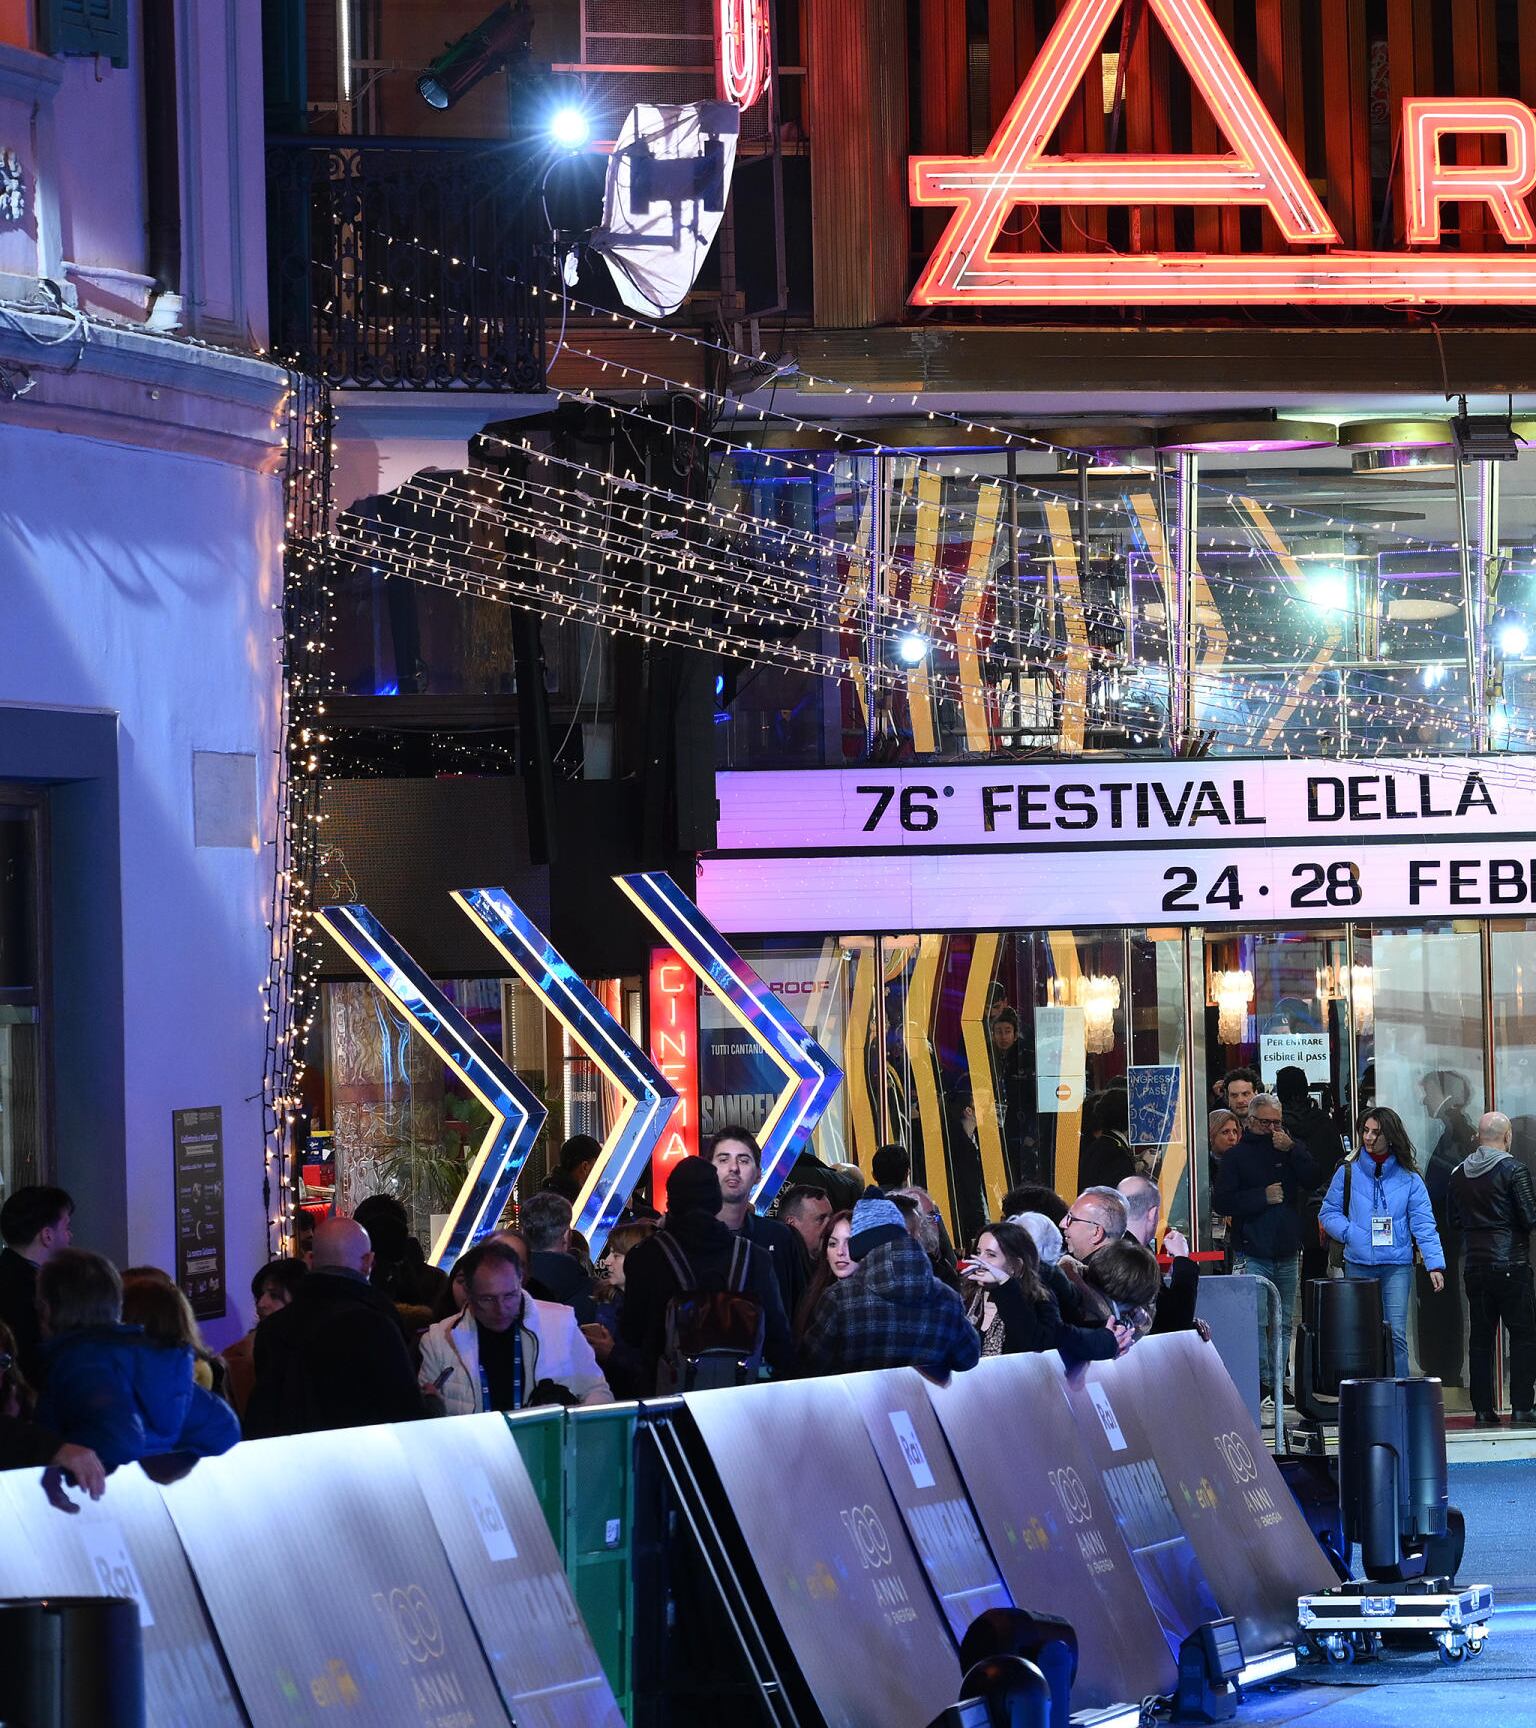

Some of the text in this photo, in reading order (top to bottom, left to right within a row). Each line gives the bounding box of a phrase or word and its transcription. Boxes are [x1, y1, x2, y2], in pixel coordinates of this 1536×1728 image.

[982, 779, 1267, 832] FESTIVAL
[1308, 771, 1496, 822] DELLA
[659, 966, 689, 1162] CINEMA
[711, 1043, 764, 1056] TUTTI CANTANO
[1130, 1073, 1178, 1084] INGRESSO
[1142, 1087, 1167, 1096] PASS
[1096, 1399, 1118, 1430] Rai
[900, 1432, 925, 1467] Rai
[1242, 1487, 1275, 1514] ANNI
[1075, 1530, 1108, 1560] ANNI
[871, 1575, 909, 1608] ANNI
